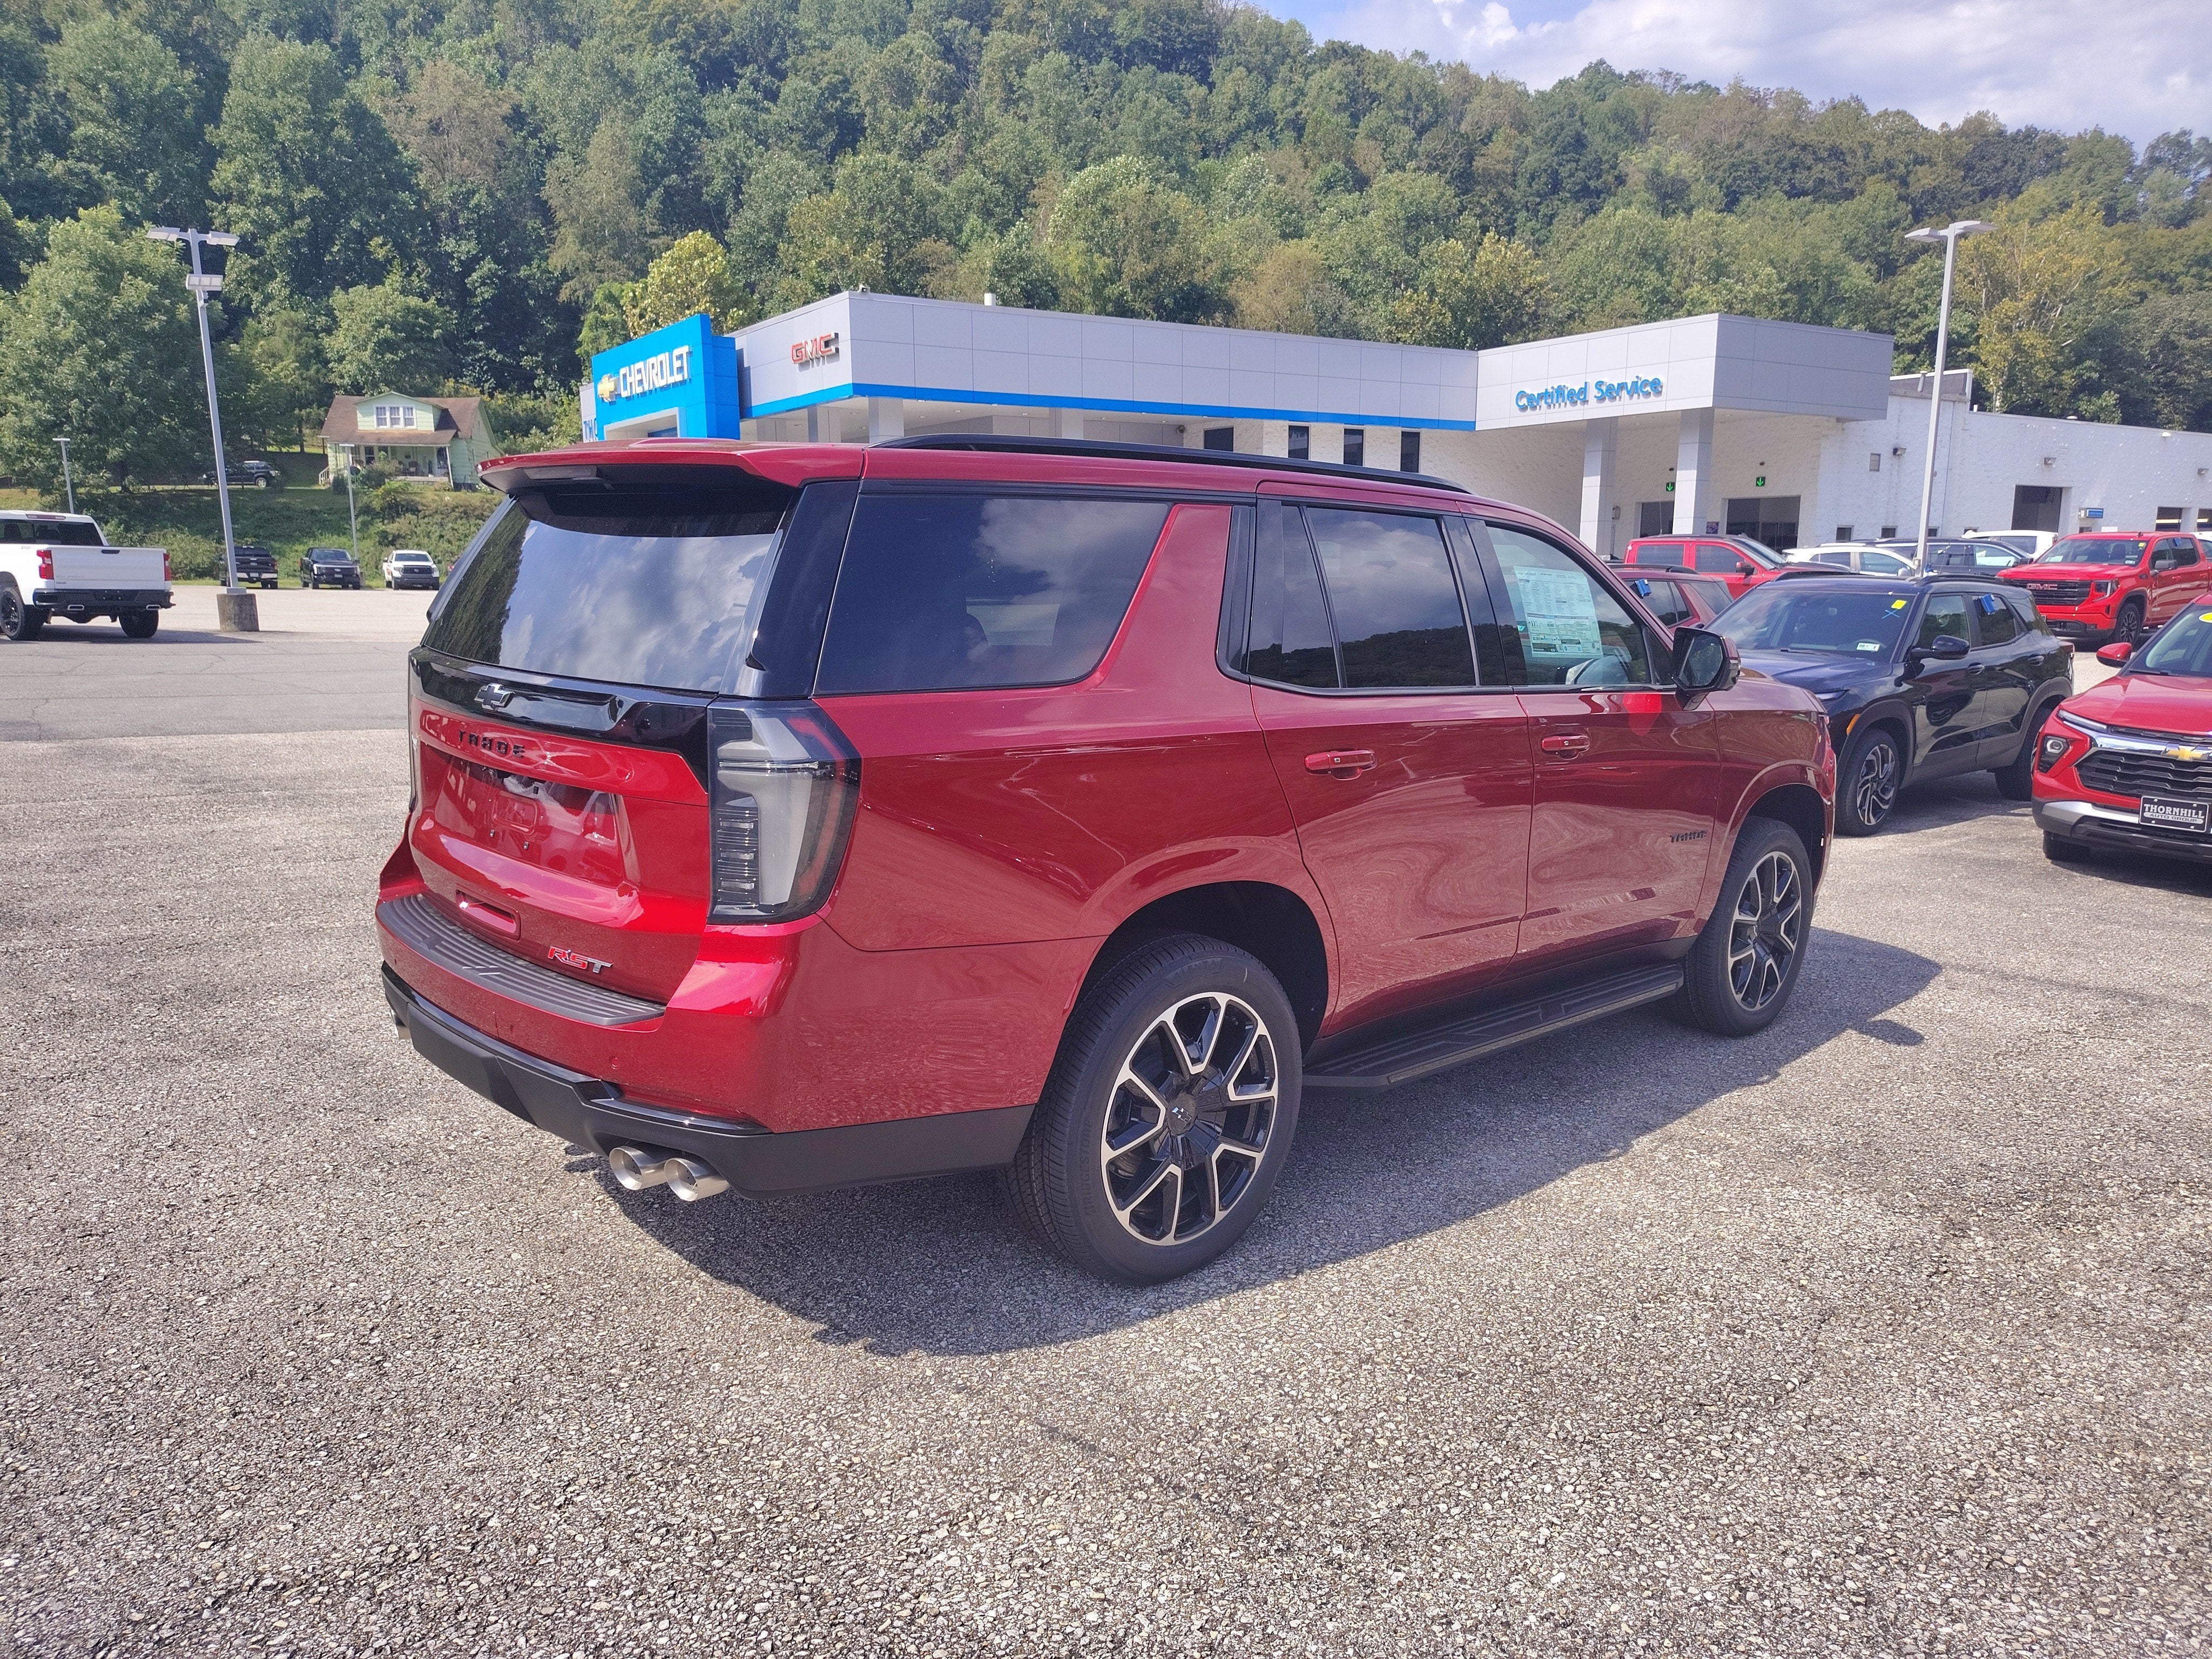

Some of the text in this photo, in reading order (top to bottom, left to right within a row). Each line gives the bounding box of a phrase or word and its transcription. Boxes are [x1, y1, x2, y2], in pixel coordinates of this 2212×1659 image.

[791, 332, 835, 365] GMC
[619, 345, 689, 398] CHEVROLET
[1515, 376, 1663, 409] Certified Service
[457, 730, 526, 758] TAHOE
[2143, 804, 2205, 819] THORNHILL
[548, 946, 614, 974] RST
